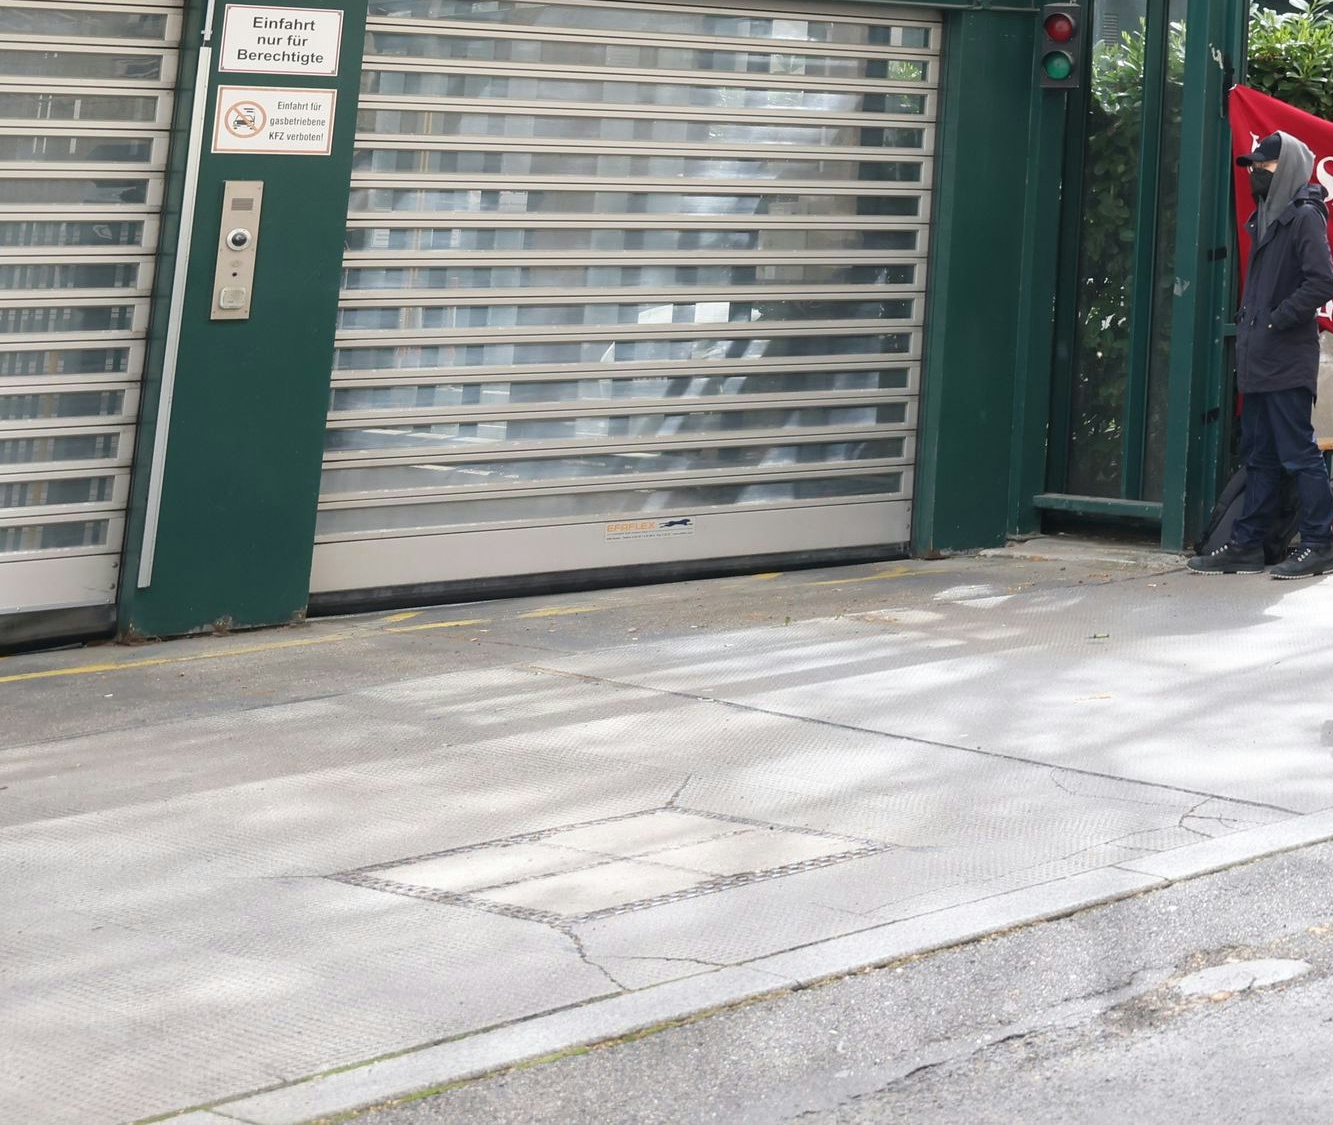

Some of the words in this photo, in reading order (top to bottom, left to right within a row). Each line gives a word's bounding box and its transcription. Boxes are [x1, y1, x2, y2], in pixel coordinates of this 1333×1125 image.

[253, 16, 316, 31] Einfahrt
[257, 36, 283, 46] nur
[287, 35, 308, 46] für
[237, 49, 324, 66] Berechtigte
[277, 101, 309, 111] Einfahrt
[310, 102, 322, 111] für
[269, 116, 326, 127] gasbetriebene
[268, 131, 285, 141] KFZ
[287, 132, 324, 142] verboten!
